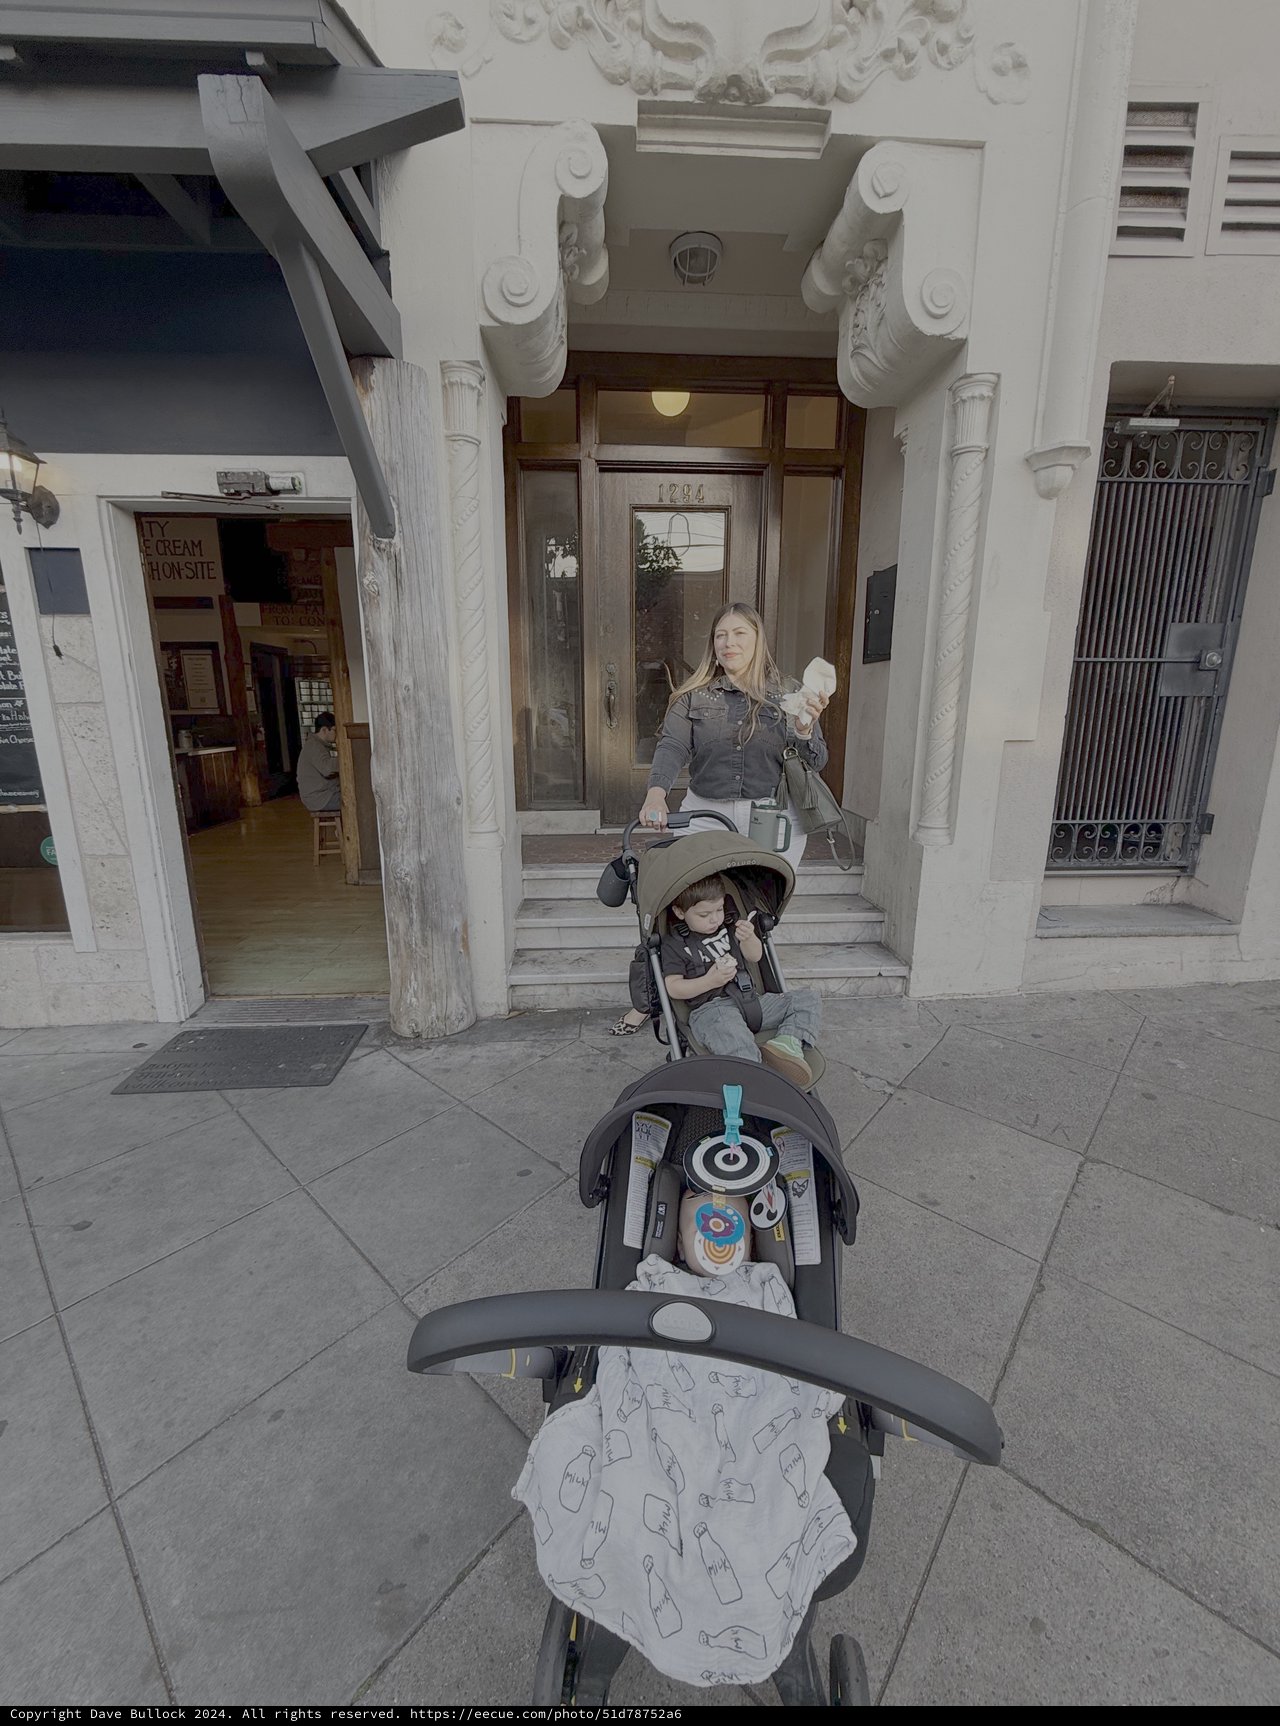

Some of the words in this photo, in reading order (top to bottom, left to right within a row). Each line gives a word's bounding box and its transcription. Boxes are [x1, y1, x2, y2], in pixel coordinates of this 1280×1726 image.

[658, 483, 705, 504] 1294
[156, 539, 204, 557] CREAM
[162, 561, 217, 580] ON-SITE
[564, 1471, 589, 1487] MILK
[590, 1520, 607, 1535] MIL
[658, 1503, 672, 1535] MILK
